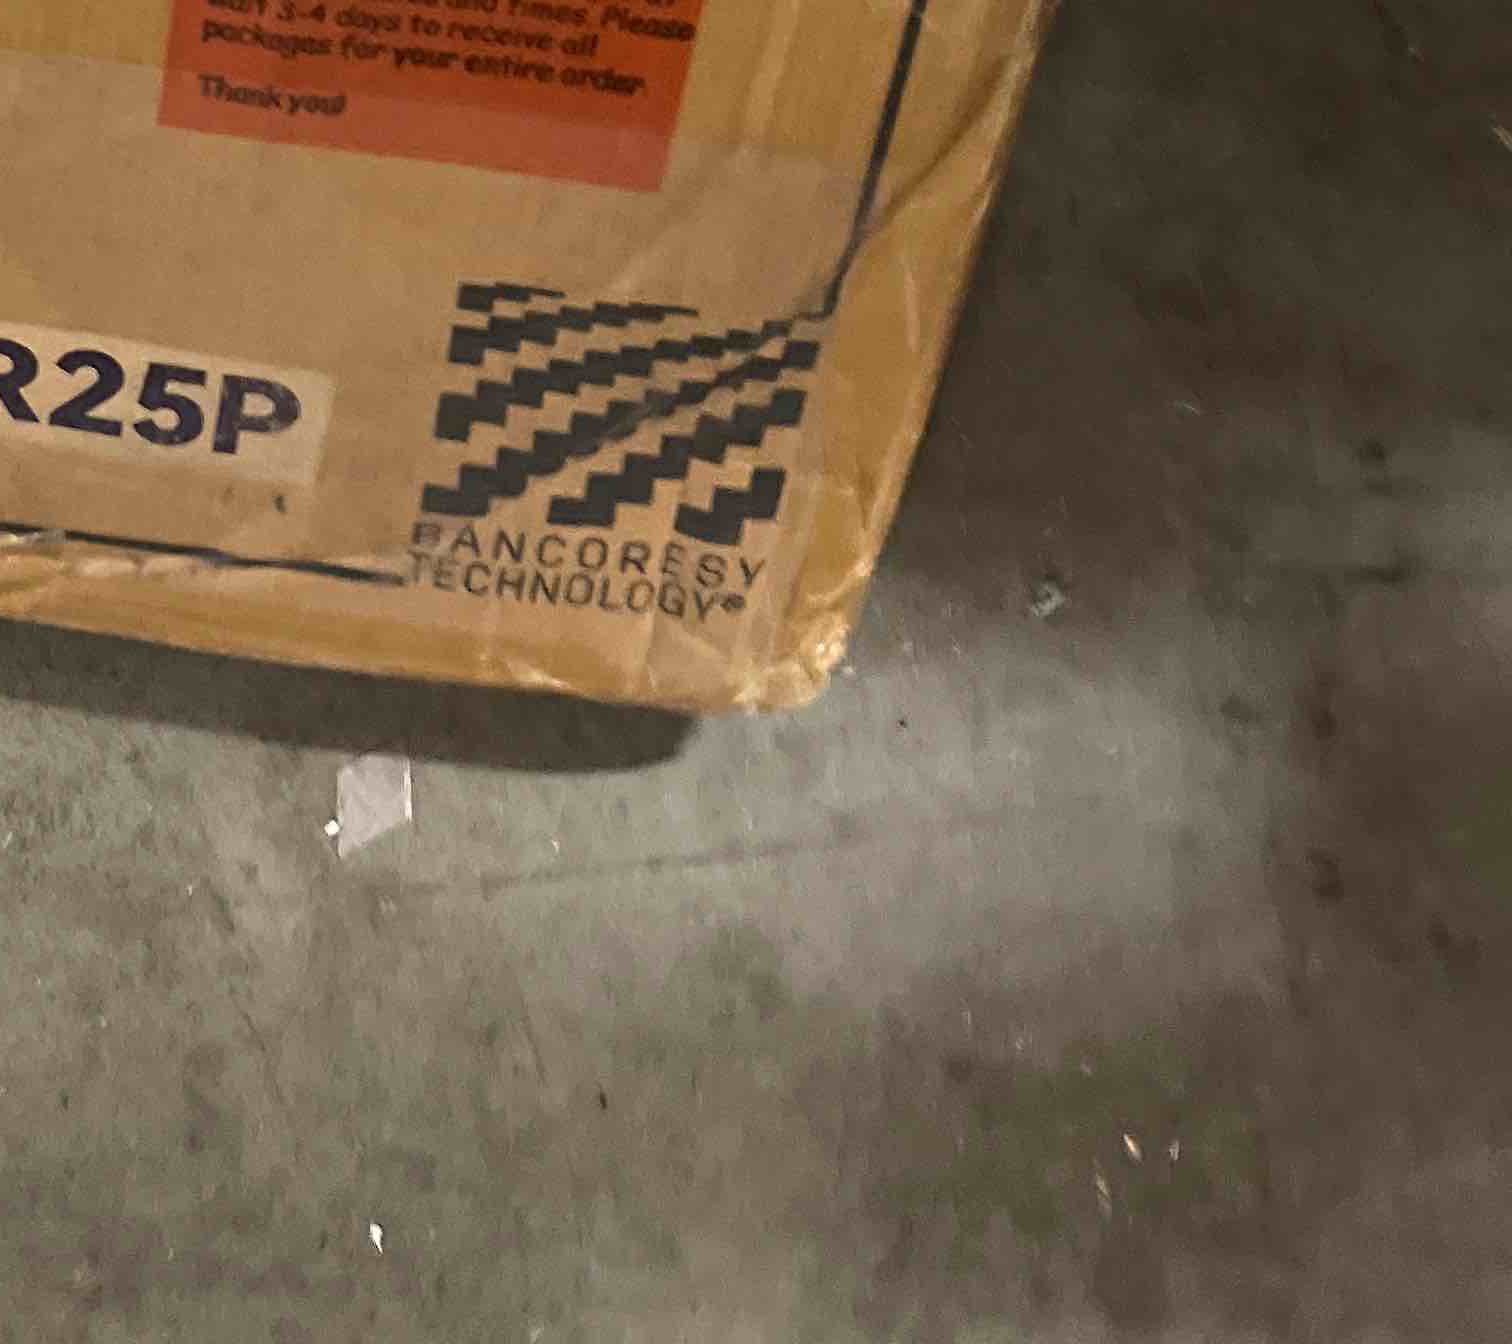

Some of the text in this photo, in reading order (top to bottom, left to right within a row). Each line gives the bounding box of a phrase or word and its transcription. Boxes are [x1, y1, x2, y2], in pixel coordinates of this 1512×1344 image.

[276, 0, 328, 24] 3-4
[335, 6, 403, 34] days
[409, 13, 442, 37] to
[599, 4, 697, 43] Please
[200, 18, 334, 60] packages
[340, 34, 388, 61] for
[393, 46, 460, 71] your
[198, 72, 283, 109] Thank
